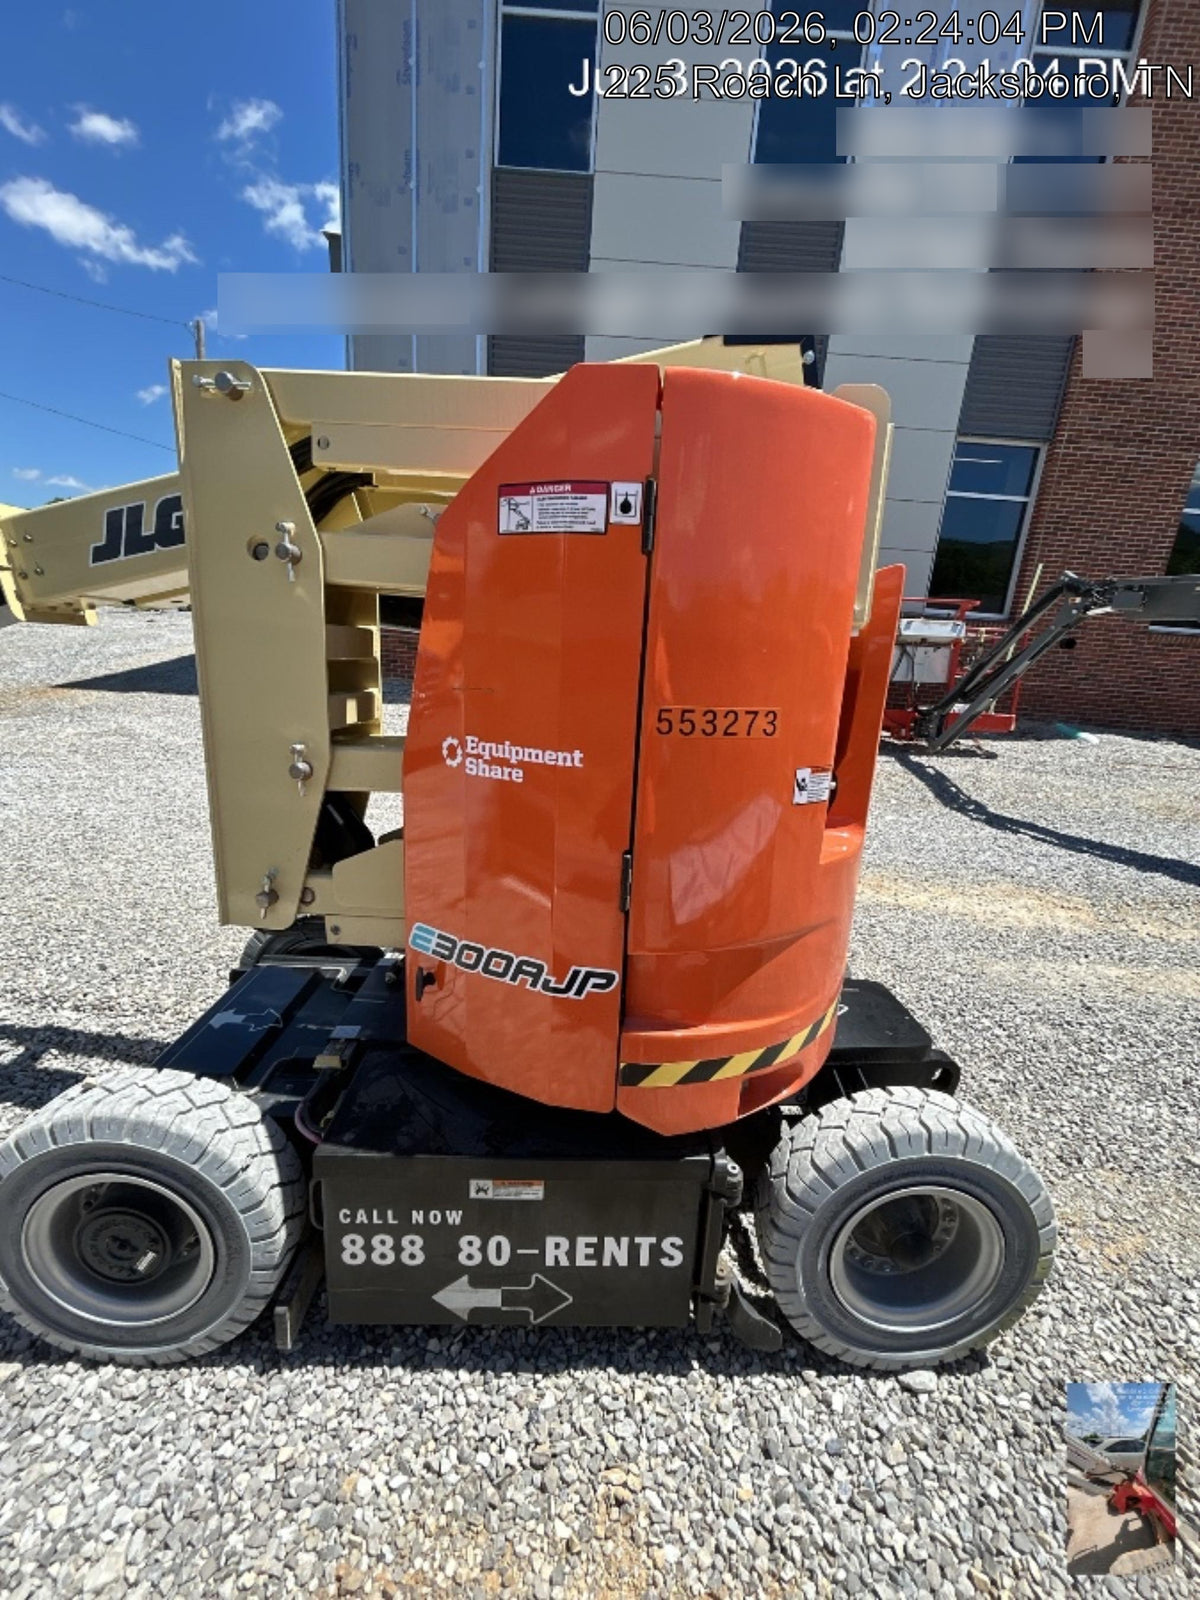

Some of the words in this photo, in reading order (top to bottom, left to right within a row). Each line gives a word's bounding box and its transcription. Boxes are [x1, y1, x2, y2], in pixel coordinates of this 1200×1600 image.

[89, 493, 187, 567] JLG
[656, 708, 778, 737] 553273
[465, 735, 584, 768] Equipment
[465, 757, 523, 783] Share
[409, 922, 619, 999] E300AJP
[339, 1208, 399, 1225] CALL
[411, 1209, 464, 1226] NOW
[341, 1234, 425, 1267] 888
[457, 1235, 684, 1267] 80-RENTS
